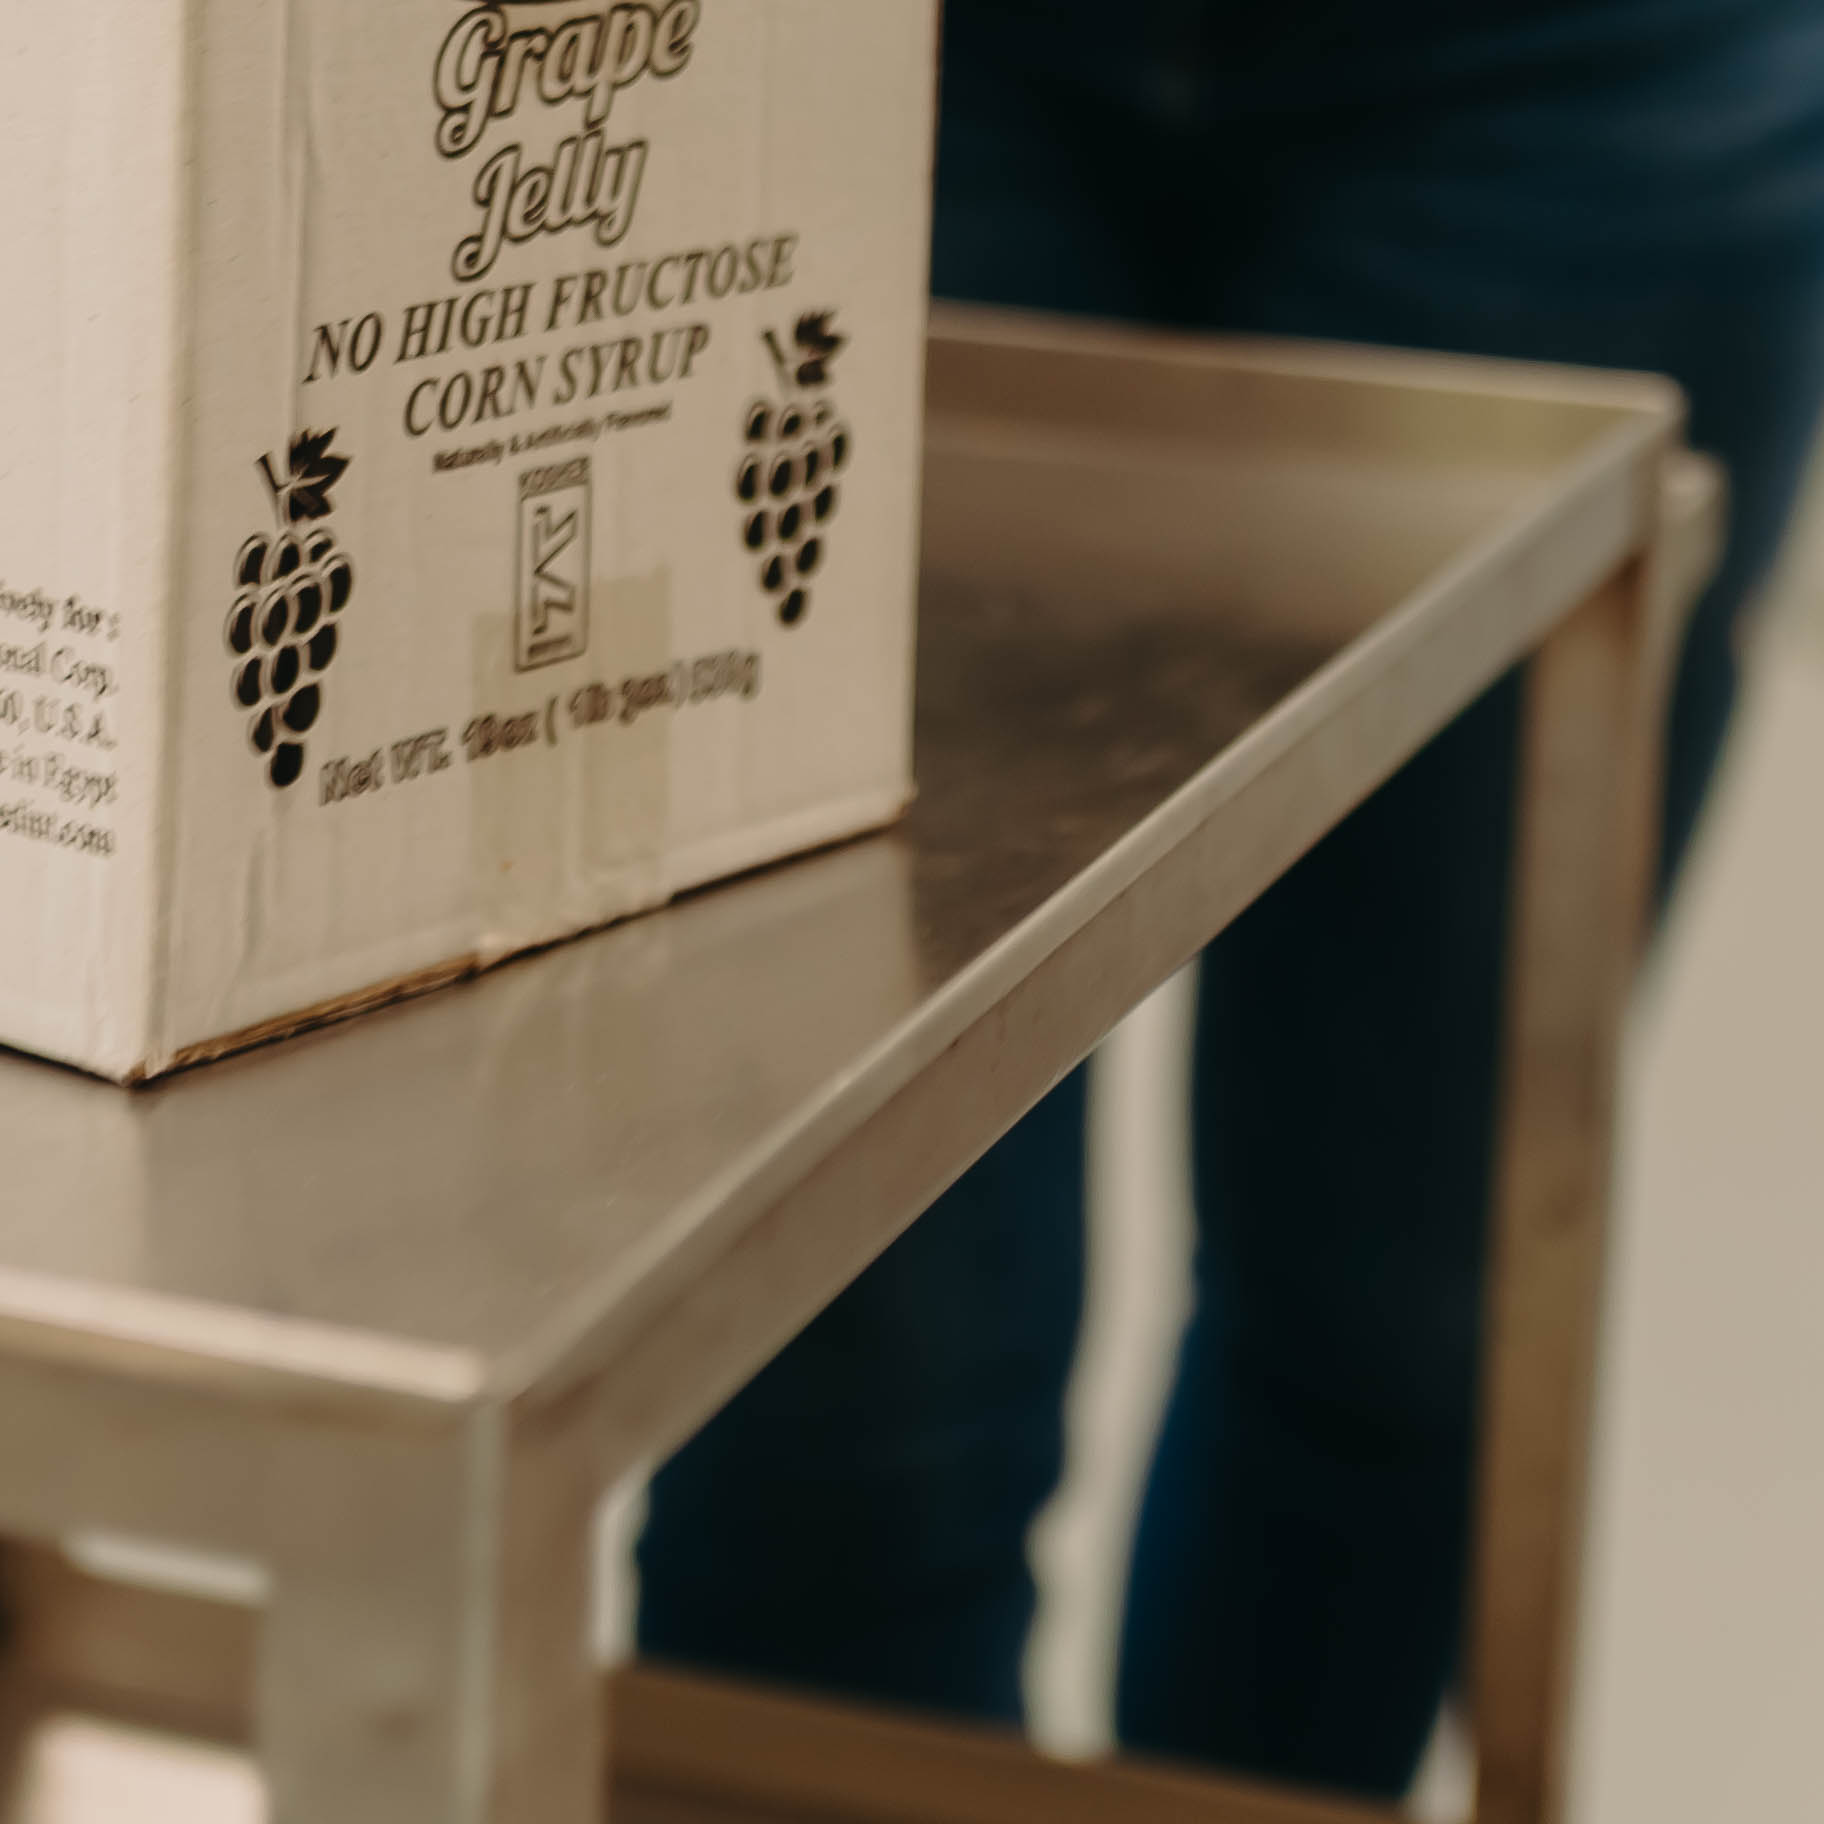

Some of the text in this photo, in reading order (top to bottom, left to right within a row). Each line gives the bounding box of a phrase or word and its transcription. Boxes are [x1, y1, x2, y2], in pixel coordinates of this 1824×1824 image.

[451, 126, 647, 283] Jelly
[303, 233, 800, 384] NO HIGH FRUCTOSE
[402, 324, 712, 439] CORN SYRUP
